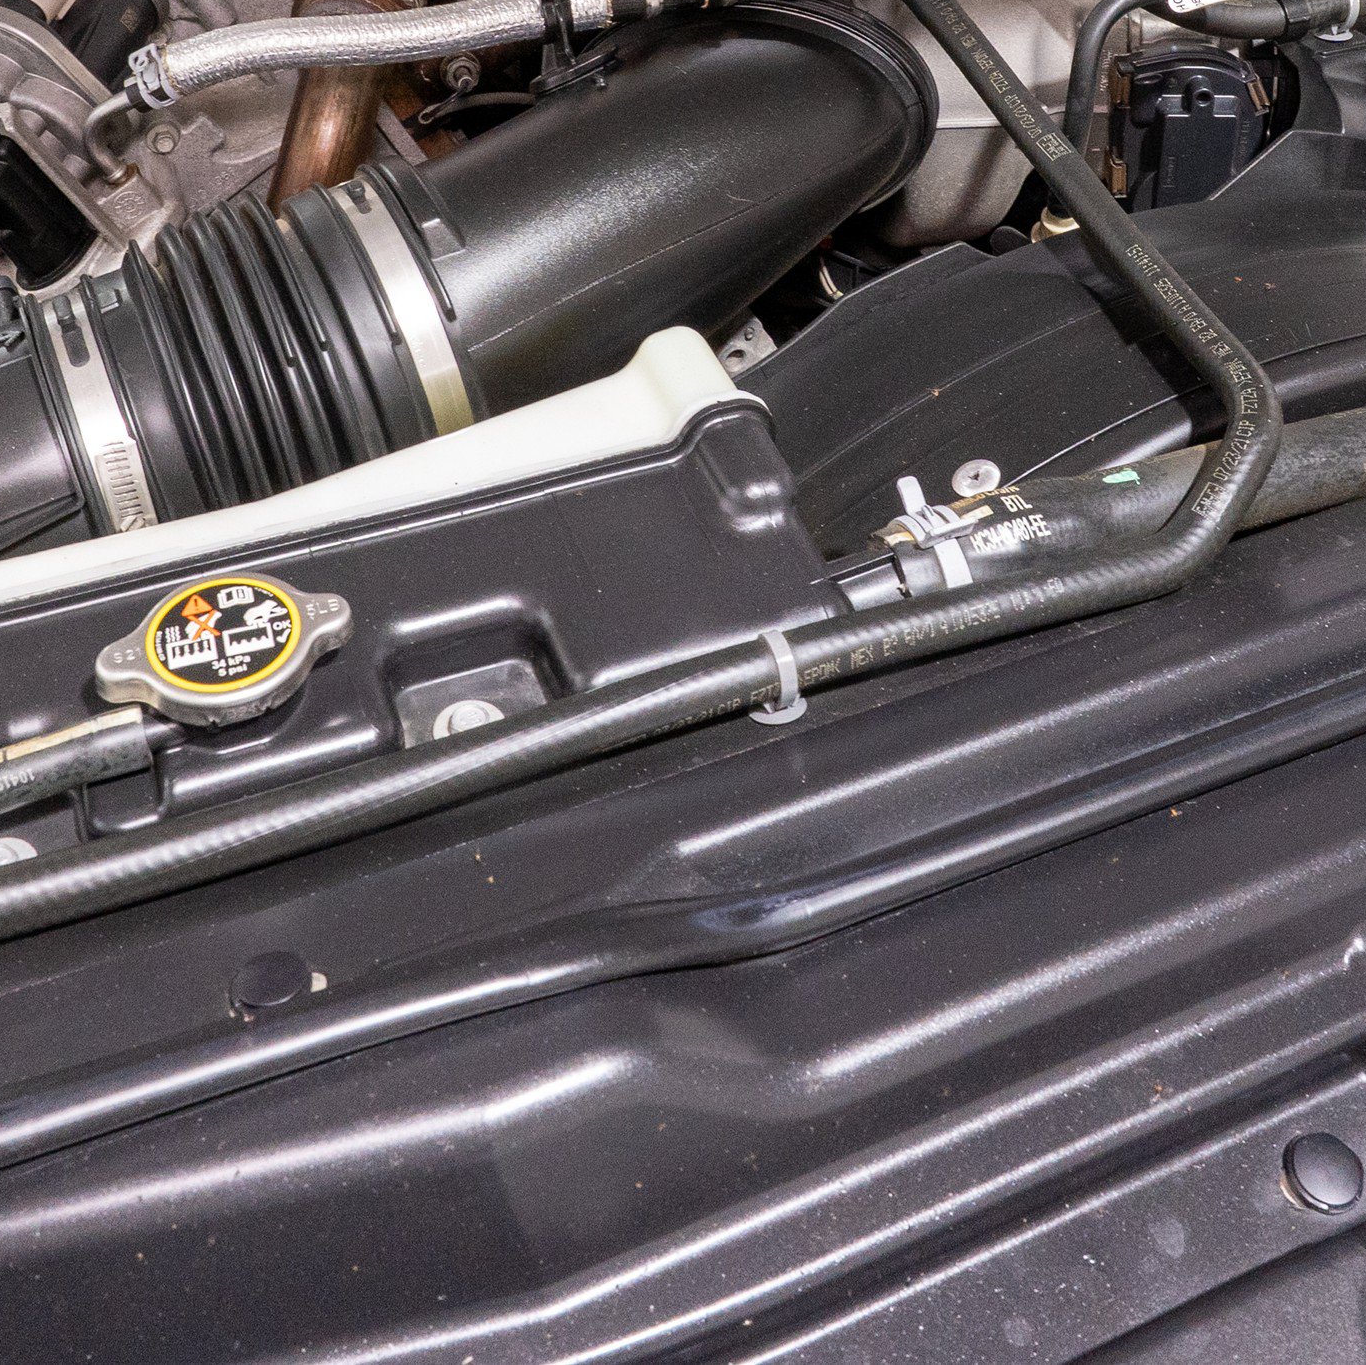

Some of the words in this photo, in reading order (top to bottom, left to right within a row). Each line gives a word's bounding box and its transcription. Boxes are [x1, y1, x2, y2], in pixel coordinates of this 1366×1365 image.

[1000, 495, 1033, 513] BTL
[272, 619, 292, 631] OK
[211, 659, 227, 669] 34
[229, 654, 251, 666] kPa
[850, 643, 874, 669] MEX
[218, 667, 227, 677] 5
[229, 665, 248, 677] psi
